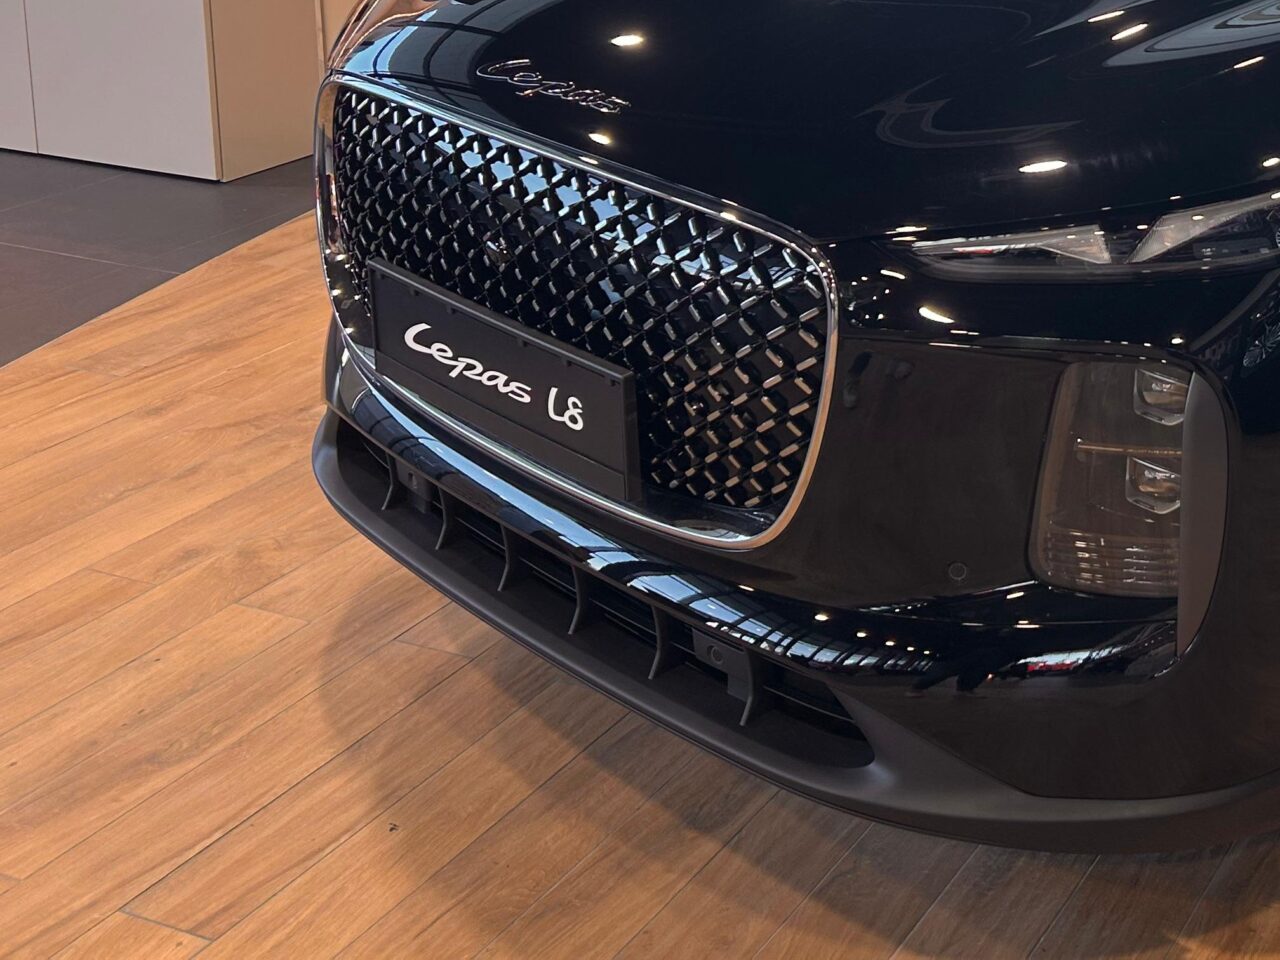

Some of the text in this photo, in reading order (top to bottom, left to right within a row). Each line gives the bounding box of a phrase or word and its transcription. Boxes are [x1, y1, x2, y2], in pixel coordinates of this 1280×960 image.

[476, 58, 632, 114] Lepas
[404, 322, 584, 431] Lepas L8
